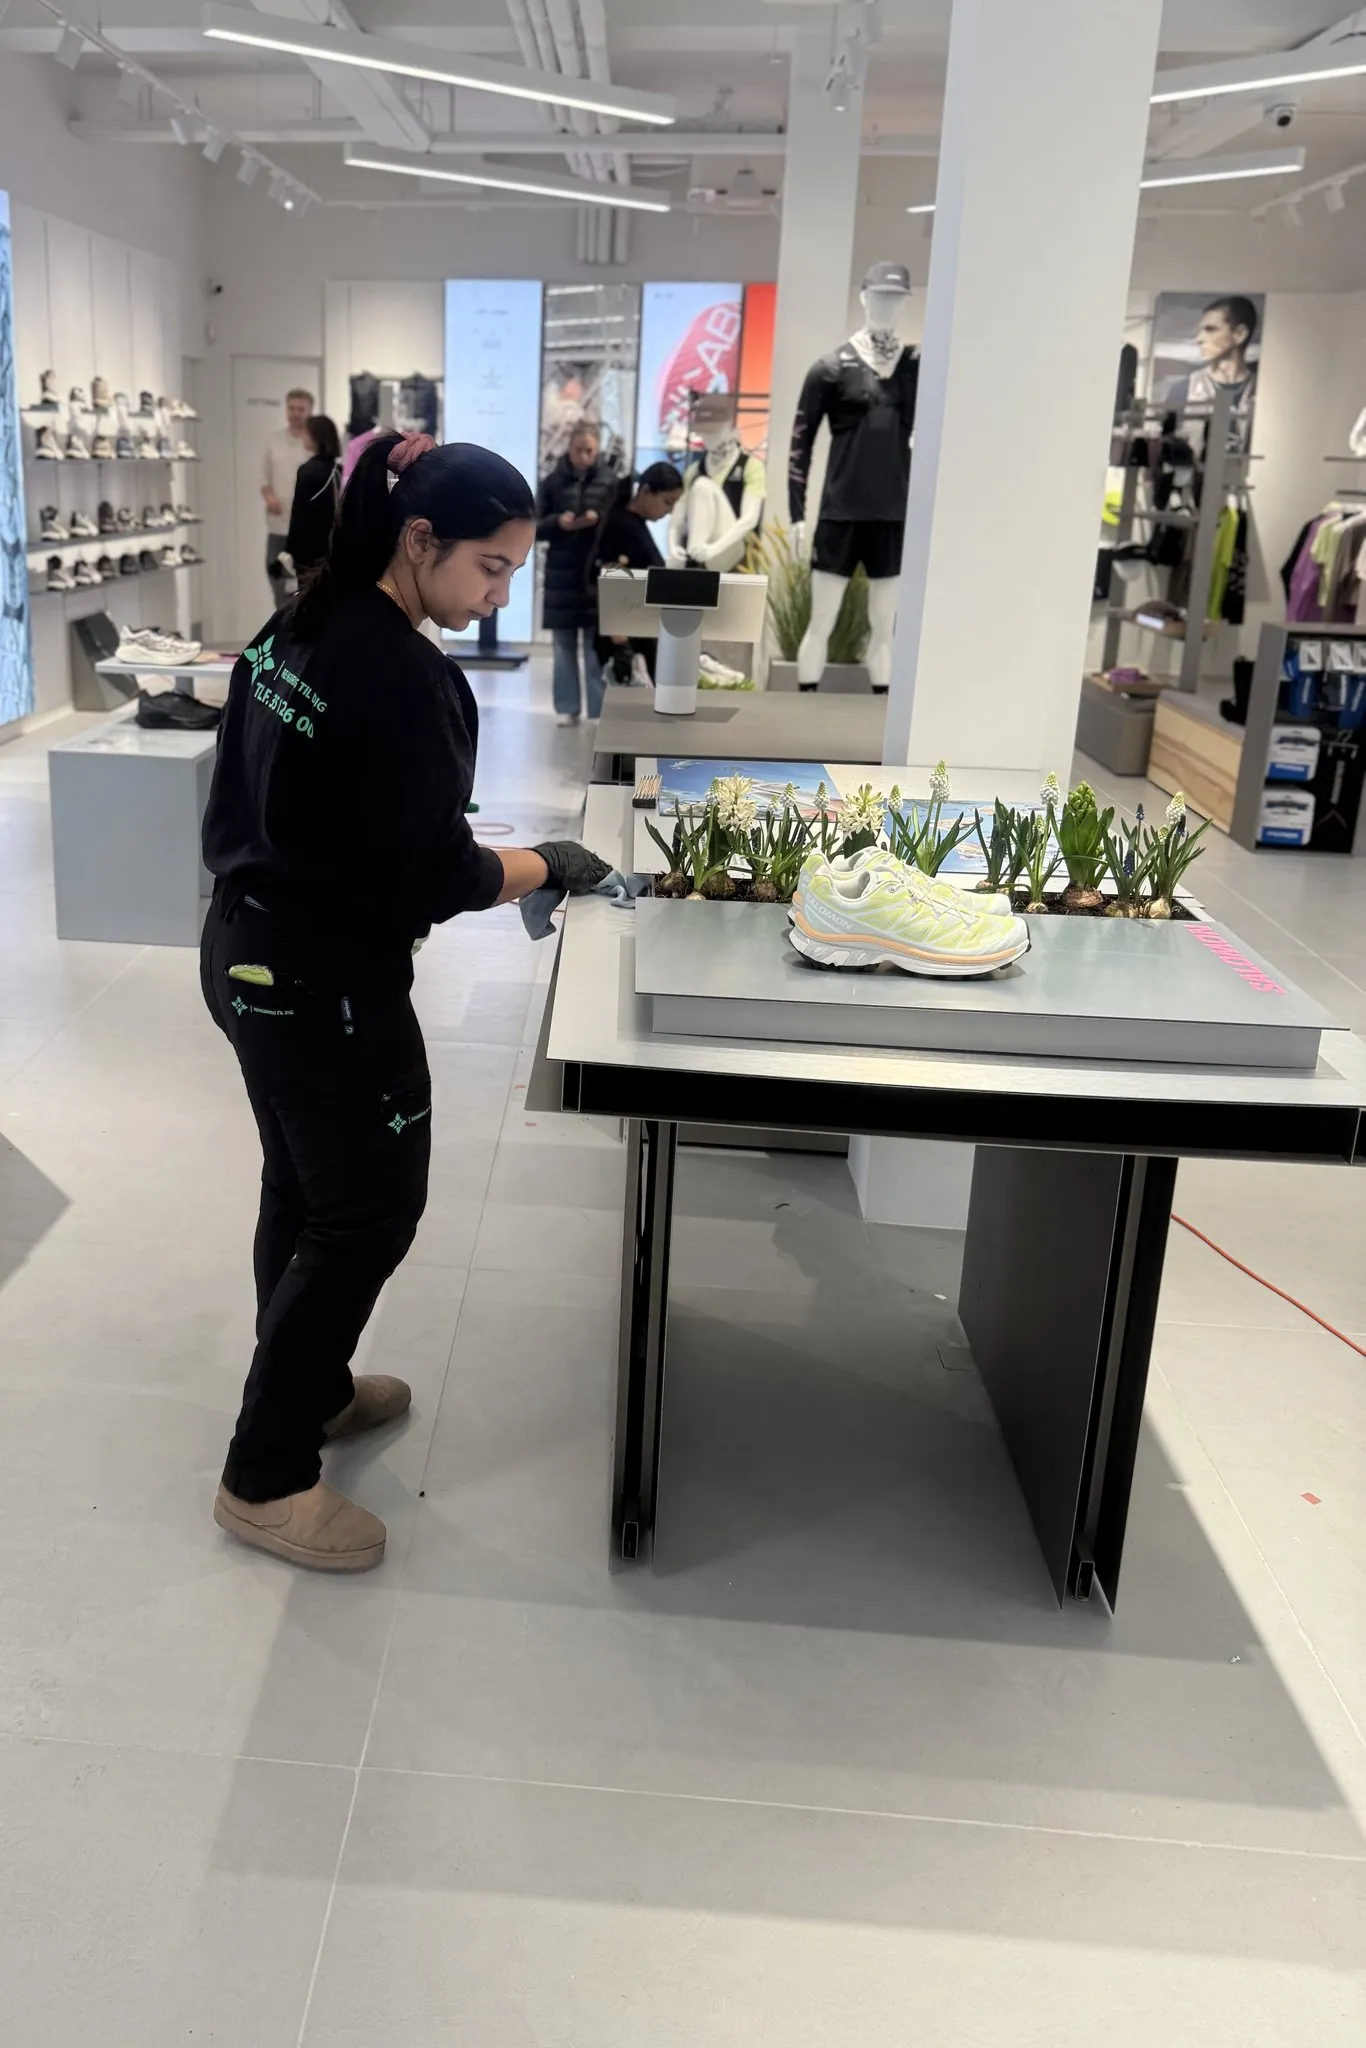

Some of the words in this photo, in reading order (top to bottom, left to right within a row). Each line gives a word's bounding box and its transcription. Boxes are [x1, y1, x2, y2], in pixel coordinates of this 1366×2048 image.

[298, 681, 313, 699] TIL
[805, 893, 854, 930] SALOMON
[1181, 923, 1288, 995] SALOMON
